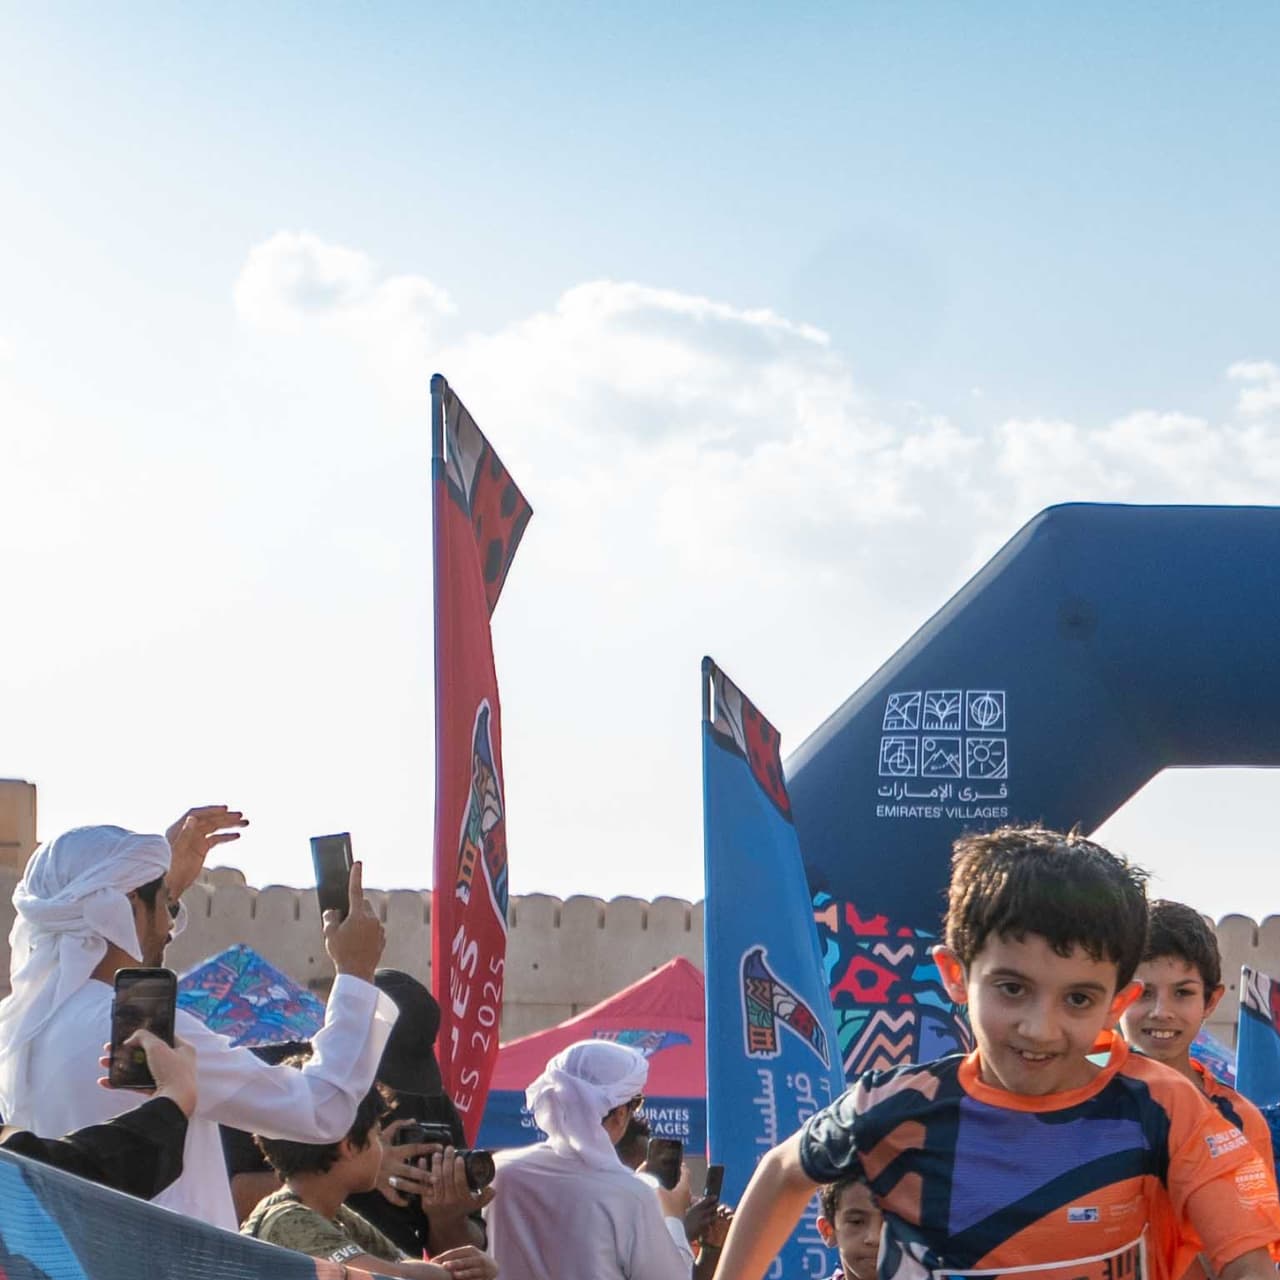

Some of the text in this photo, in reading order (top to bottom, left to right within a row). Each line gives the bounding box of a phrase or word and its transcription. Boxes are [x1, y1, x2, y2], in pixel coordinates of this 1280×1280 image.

[877, 781, 1008, 803] قرى الإمارات
[945, 807, 1008, 819] VILLAGES
[471, 956, 505, 1053] 2025
[648, 1121, 690, 1136] AGES
